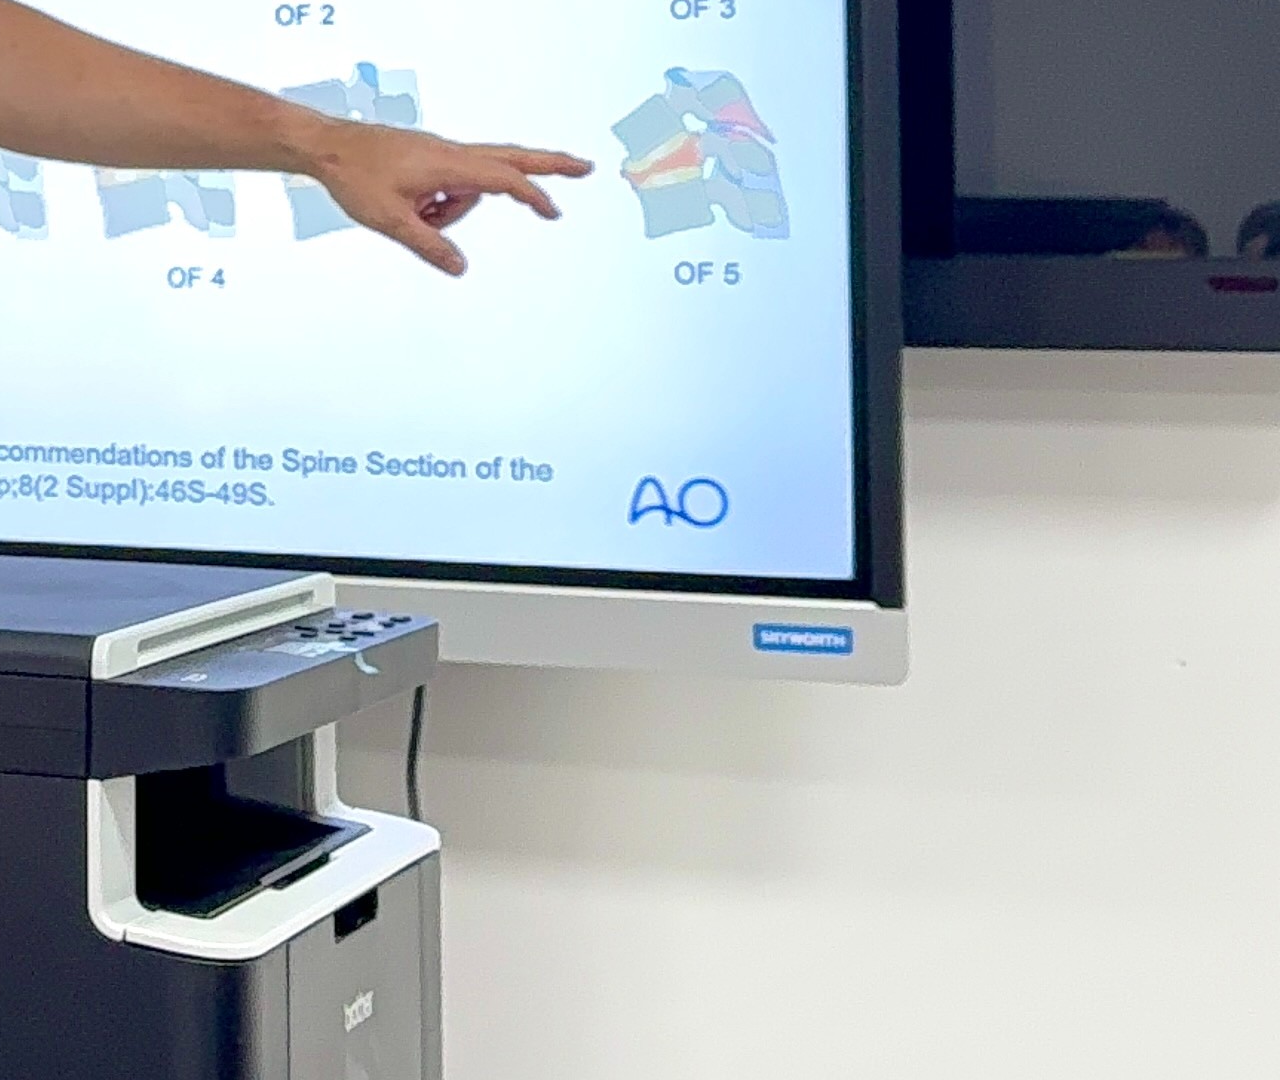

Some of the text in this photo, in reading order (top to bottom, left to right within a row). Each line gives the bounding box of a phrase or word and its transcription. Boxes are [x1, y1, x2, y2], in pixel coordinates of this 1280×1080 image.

[274, 3, 336, 27] OF 2
[166, 266, 226, 289] OF 4
[674, 260, 741, 286] OF 5
[200, 445, 226, 470] of
[233, 447, 274, 472] the
[281, 447, 358, 479] Spine
[365, 450, 467, 479] Section
[475, 456, 504, 480] of
[509, 456, 554, 483] the
[629, 476, 729, 529] AO
